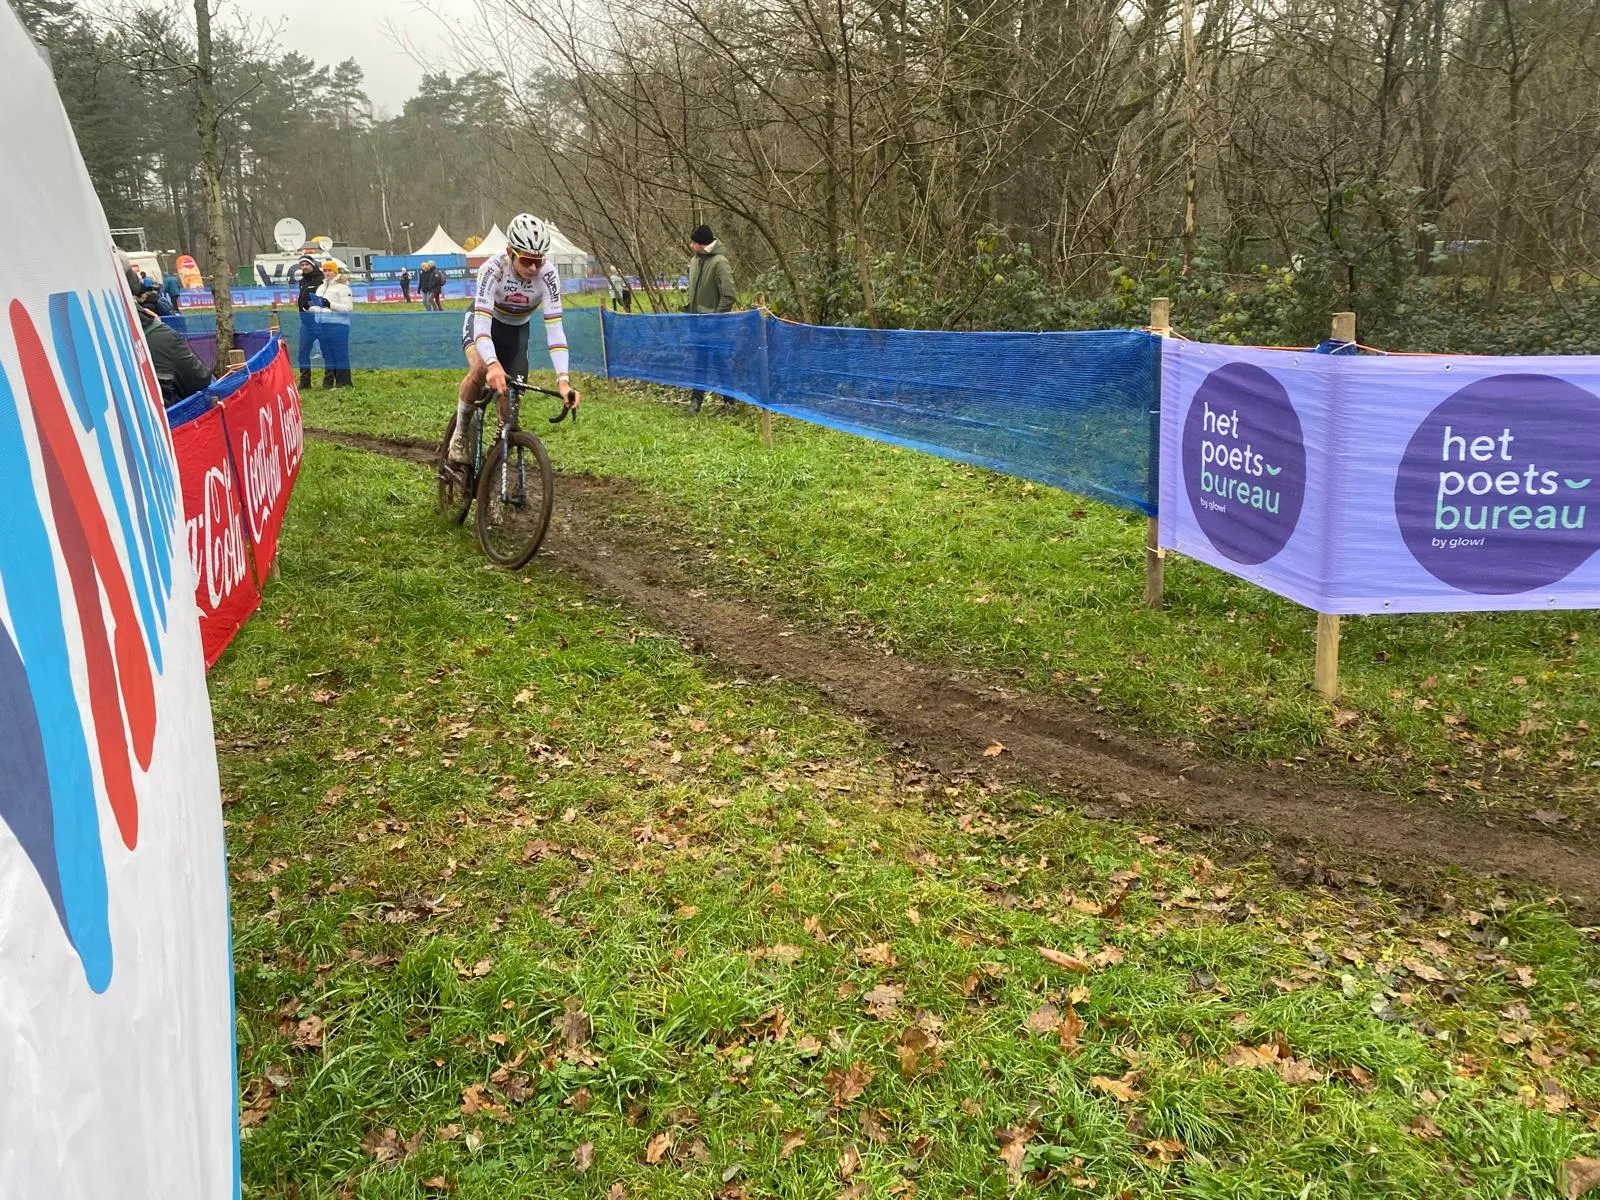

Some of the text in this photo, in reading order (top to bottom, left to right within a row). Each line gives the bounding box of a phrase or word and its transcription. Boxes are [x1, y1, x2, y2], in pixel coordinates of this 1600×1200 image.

[1203, 401, 1239, 439] het
[1201, 440, 1264, 477] poets
[1442, 426, 1515, 461] het
[1201, 465, 1280, 514] bureau
[1437, 463, 1560, 498] poets
[1200, 497, 1227, 514] by glowi
[1435, 498, 1587, 530] bureau
[1431, 537, 1486, 549] by glowi
